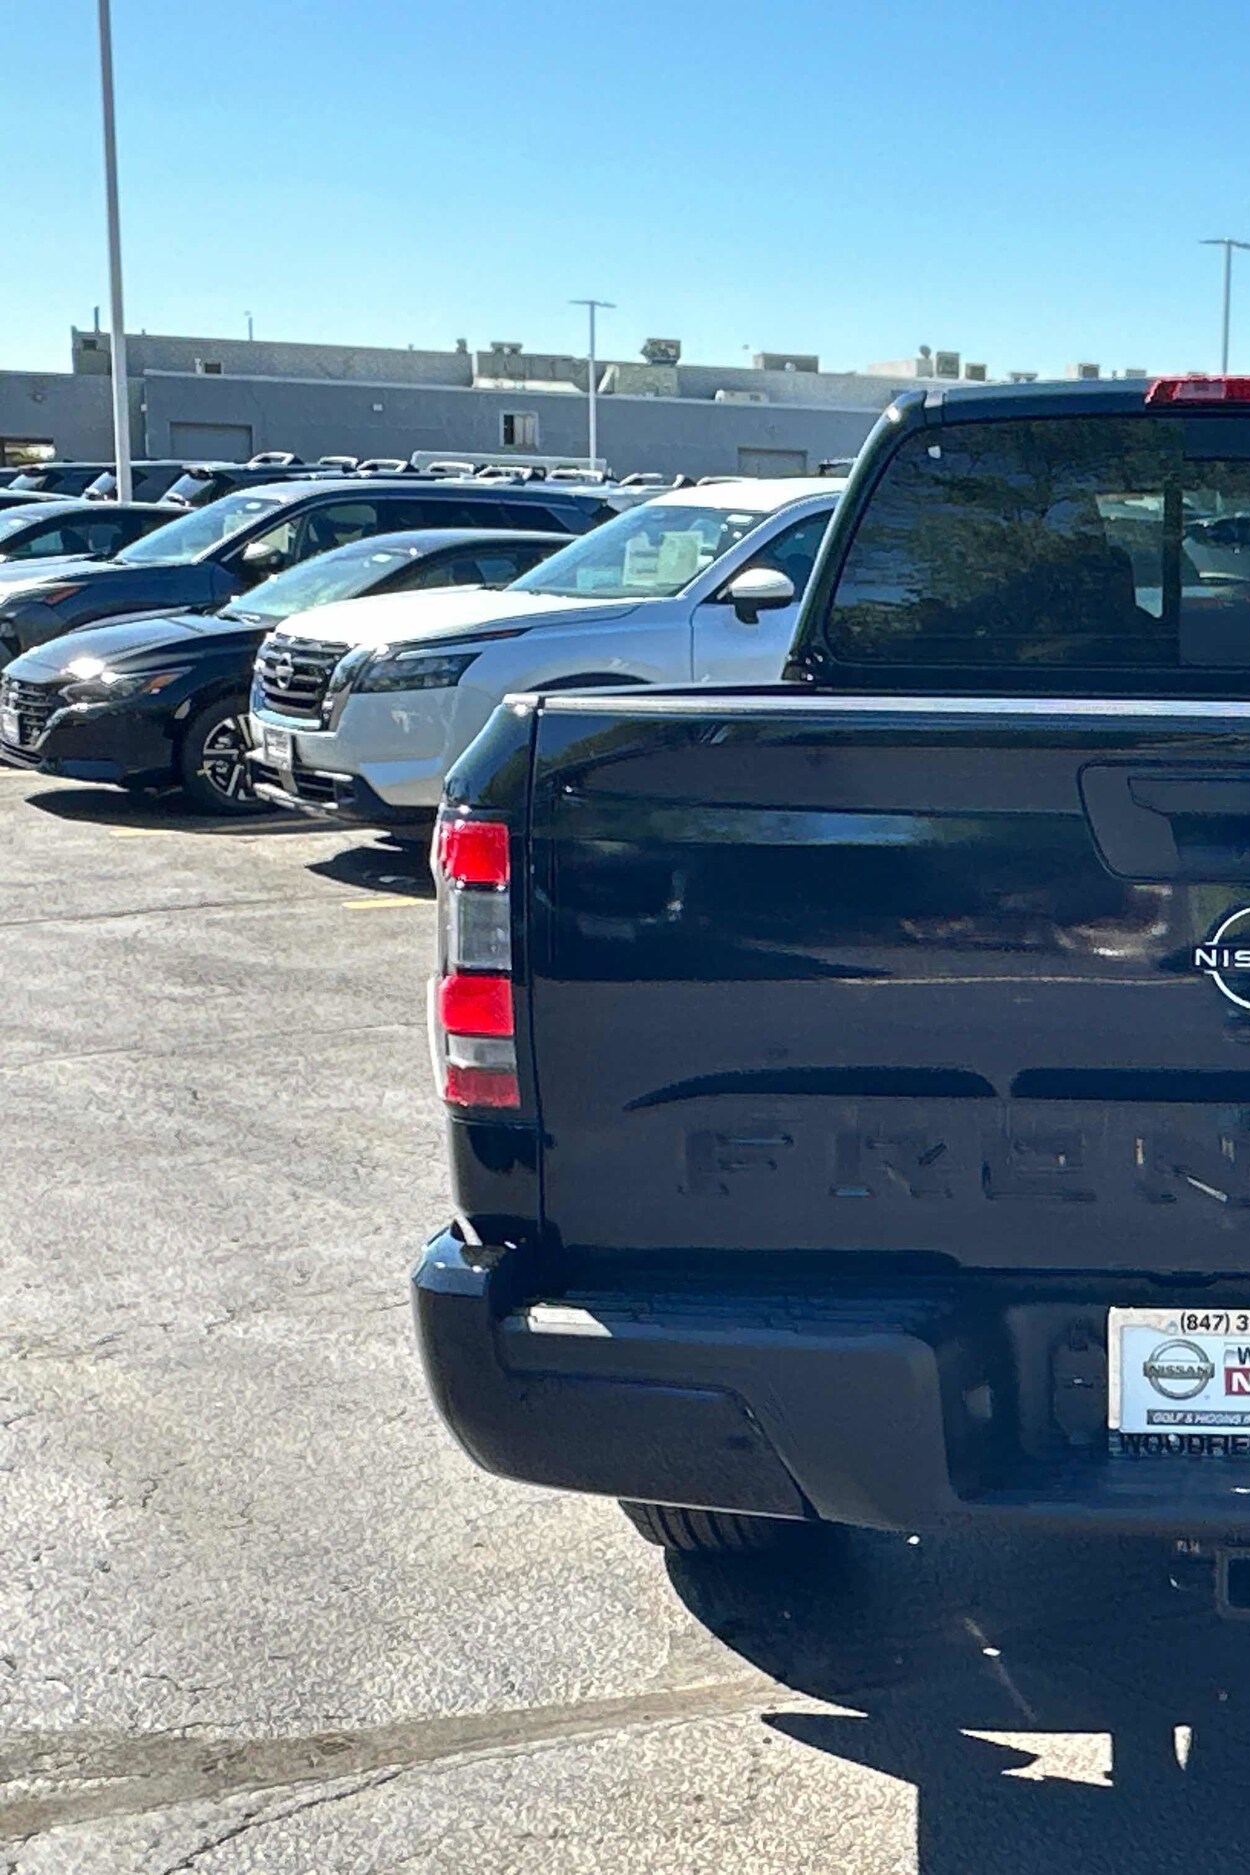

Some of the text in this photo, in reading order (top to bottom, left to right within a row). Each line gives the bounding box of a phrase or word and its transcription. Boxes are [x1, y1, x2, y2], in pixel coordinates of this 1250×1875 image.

[1180, 1312, 1230, 1334] (847)
[1150, 1364, 1209, 1376] NISSAN
[1153, 1412, 1182, 1424] GOLF
